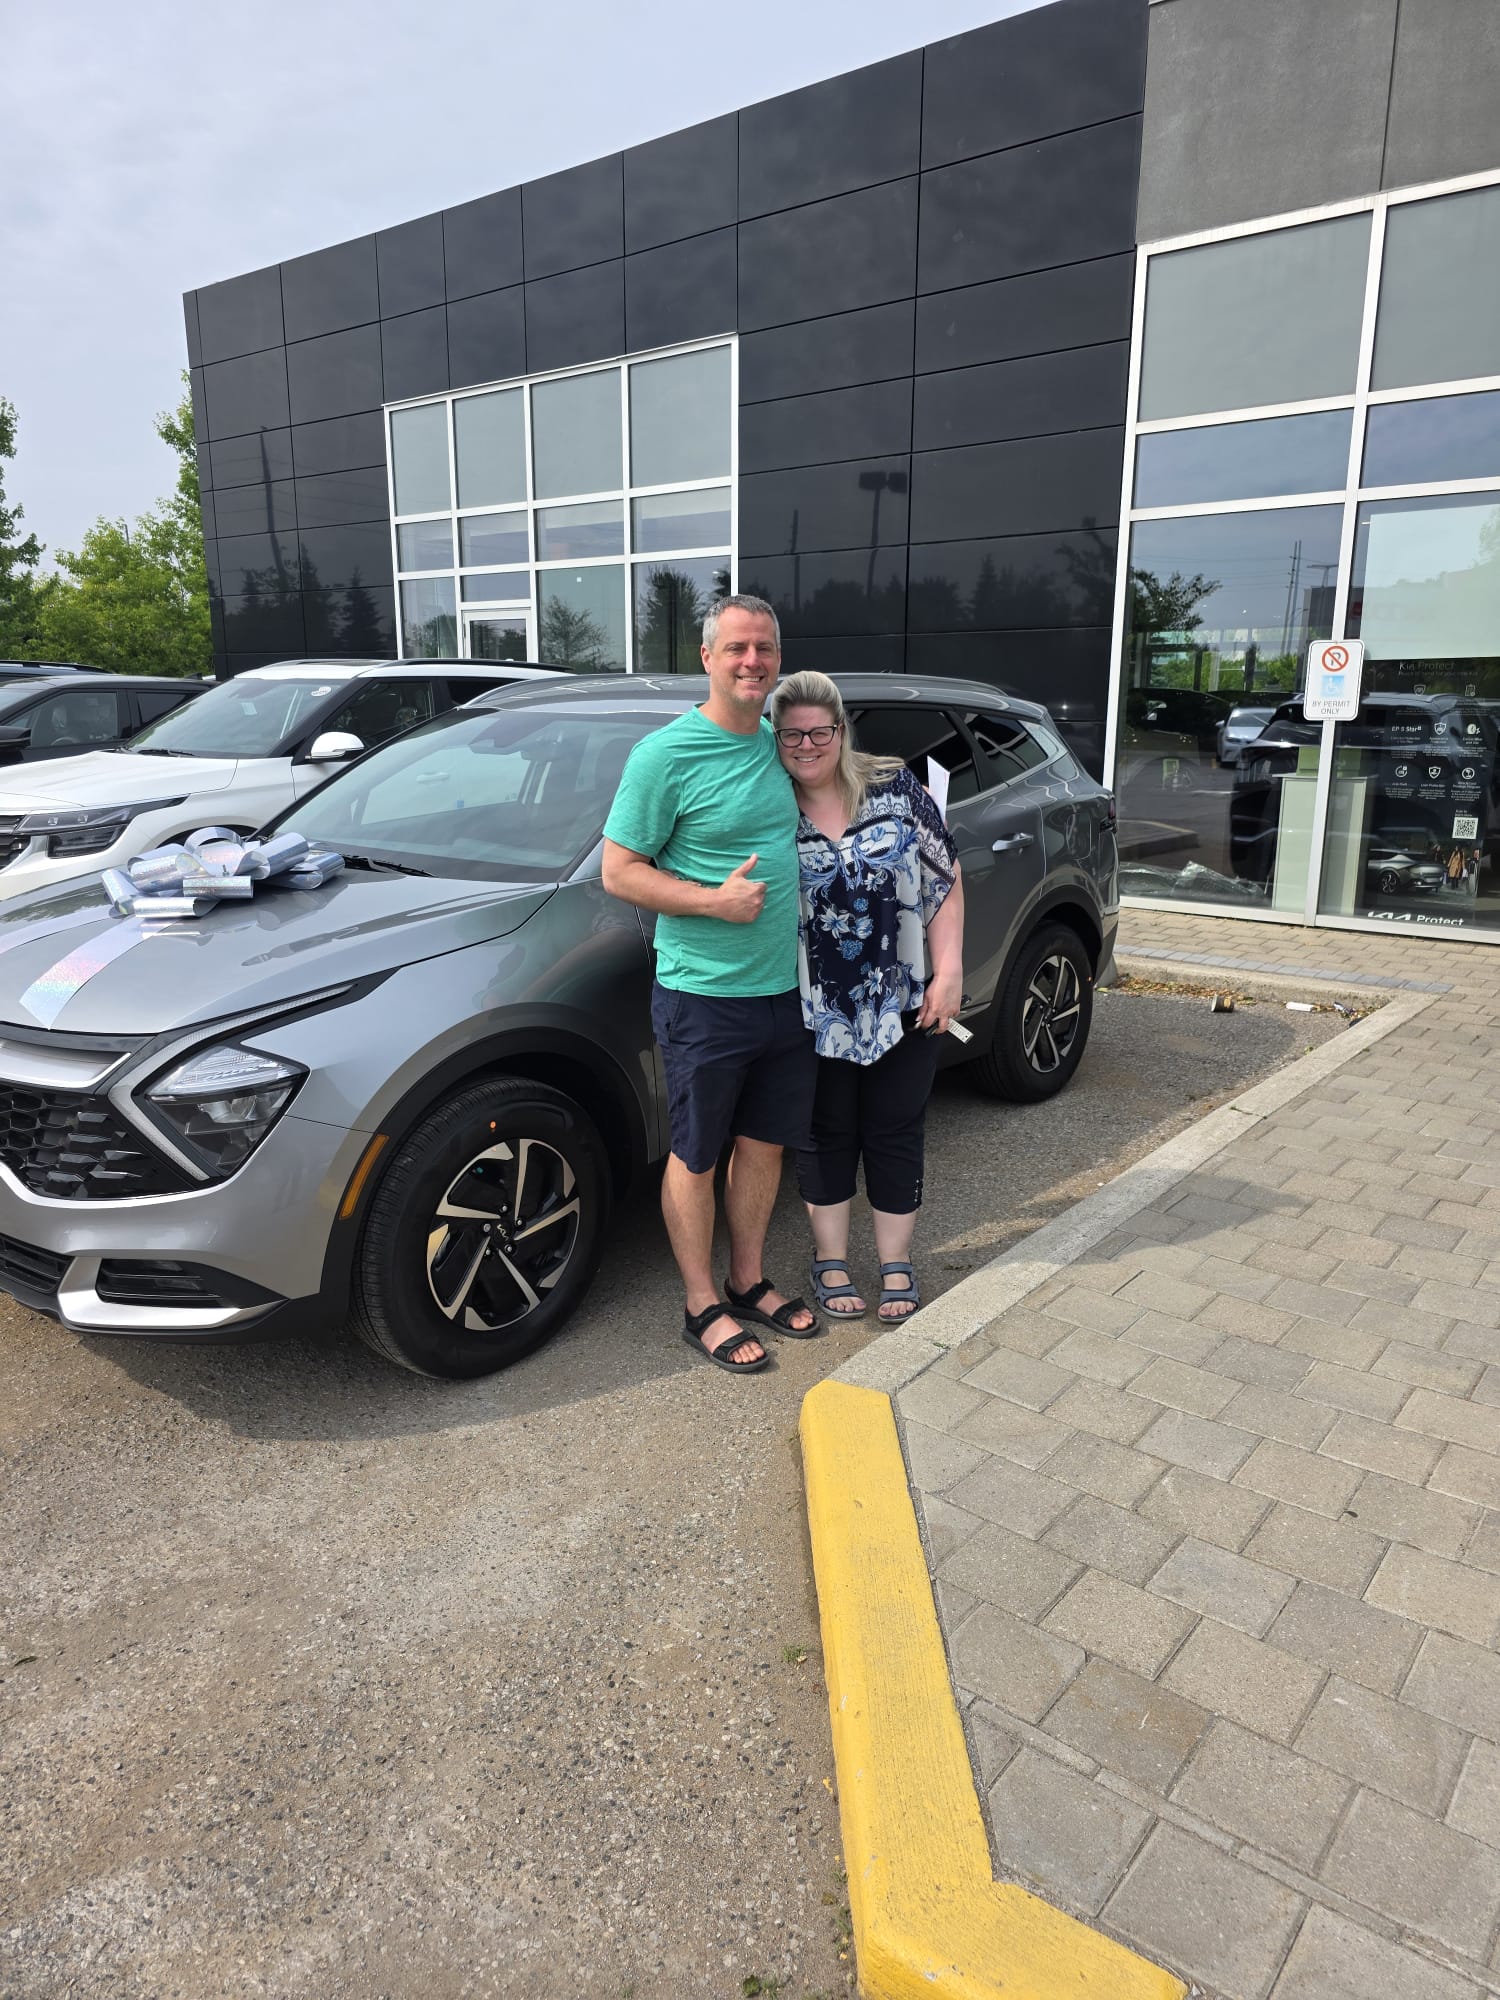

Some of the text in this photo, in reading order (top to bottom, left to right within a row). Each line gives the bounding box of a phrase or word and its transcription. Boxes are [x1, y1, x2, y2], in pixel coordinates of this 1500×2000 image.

[1400, 661, 1455, 671] Kia Protect
[1312, 700, 1350, 708] BY PERMIT
[1320, 707, 1340, 715] ONLY
[1417, 915, 1464, 926] Protect
